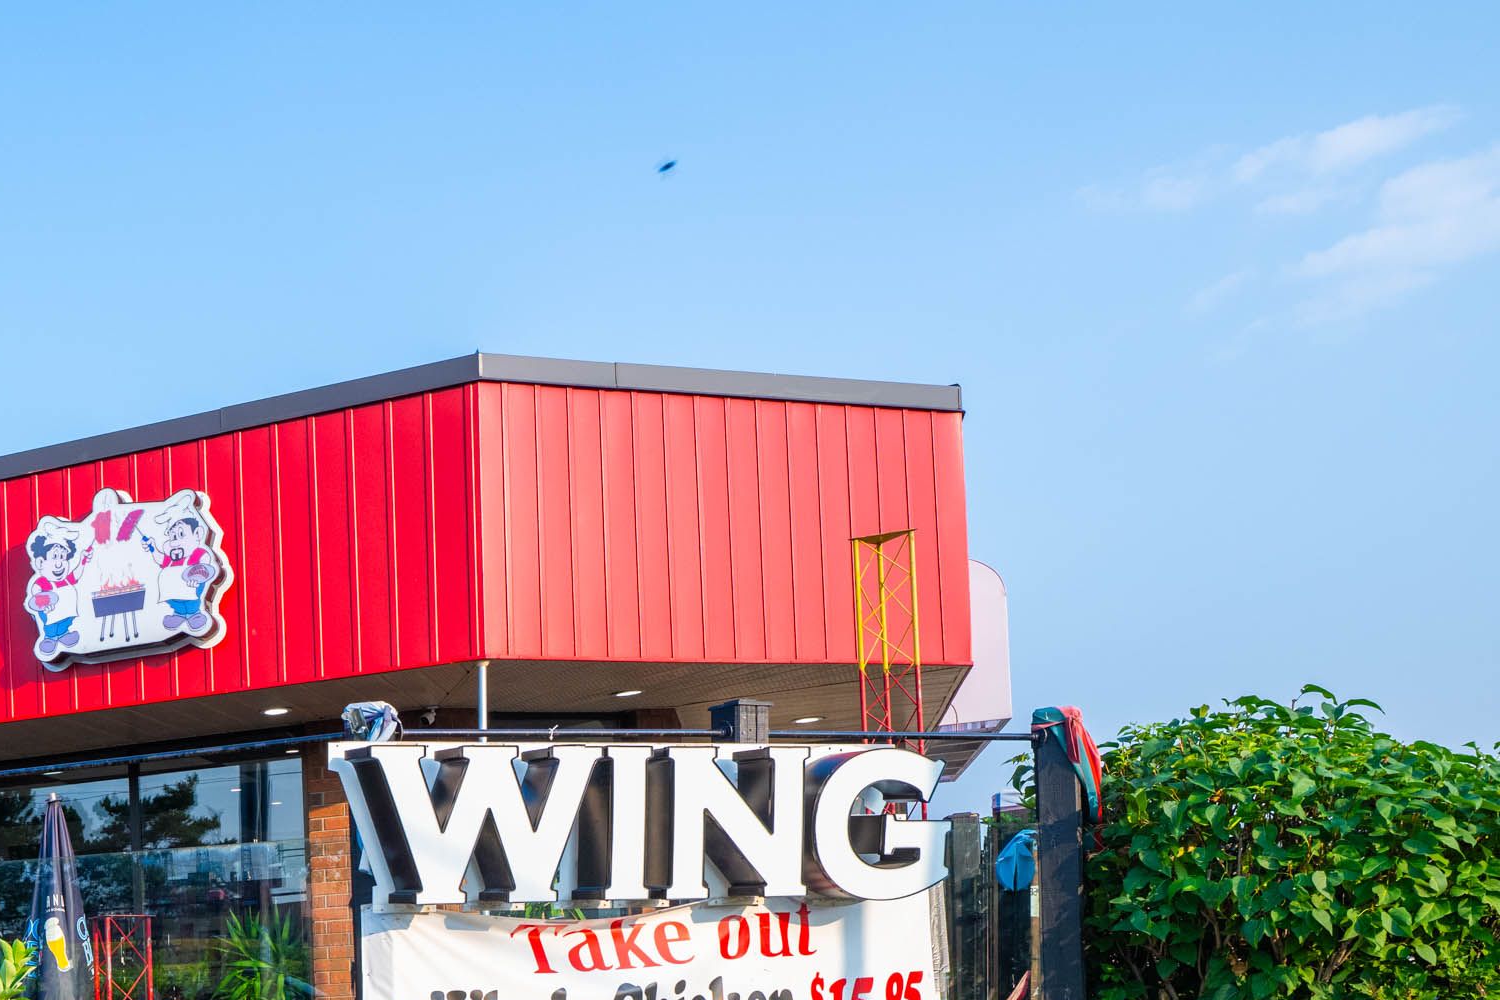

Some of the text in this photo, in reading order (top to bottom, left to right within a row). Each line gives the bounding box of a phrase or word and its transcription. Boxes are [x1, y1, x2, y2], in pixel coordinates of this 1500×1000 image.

[345, 743, 952, 902] WING
[511, 903, 818, 976] Take out
